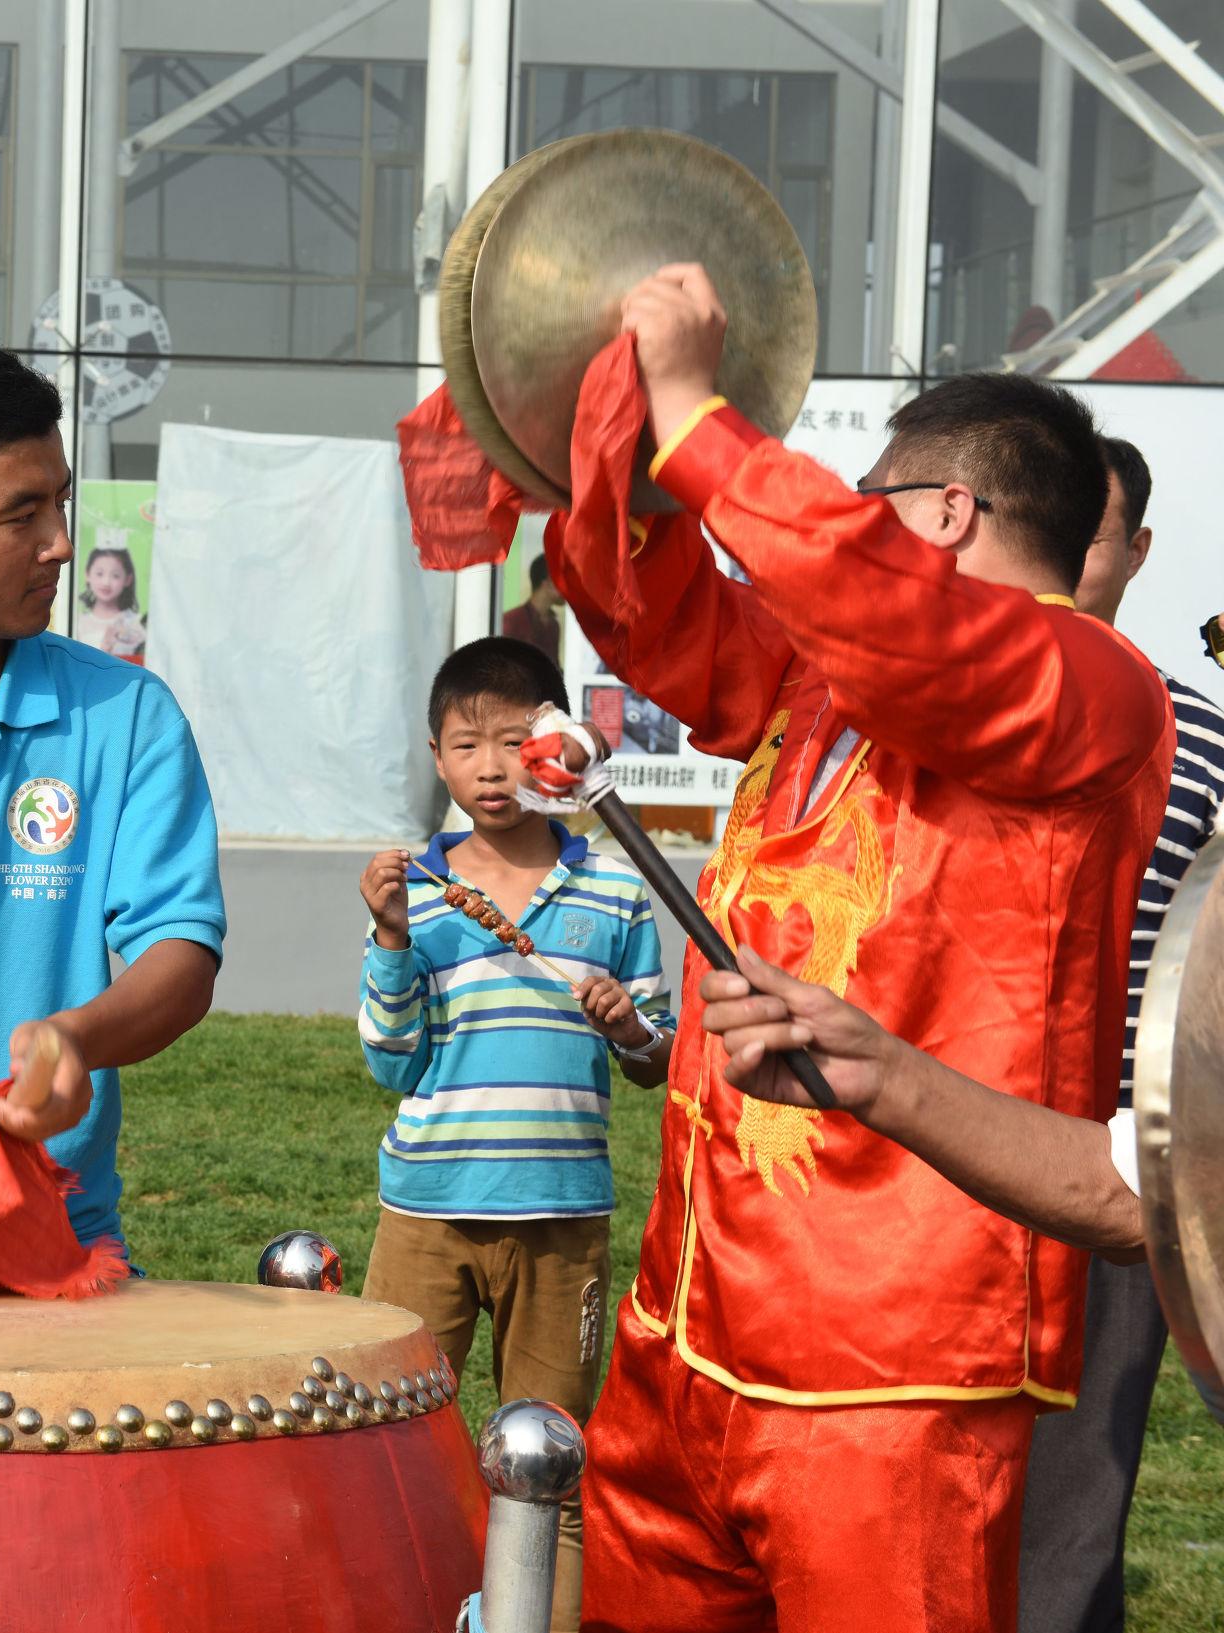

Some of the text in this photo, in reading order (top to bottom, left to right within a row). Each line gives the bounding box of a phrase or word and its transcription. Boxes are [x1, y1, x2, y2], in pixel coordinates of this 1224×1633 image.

[12, 863, 33, 874] 6TH
[34, 864, 85, 875] SHANDONG
[5, 875, 74, 887] FLOWER EXPO
